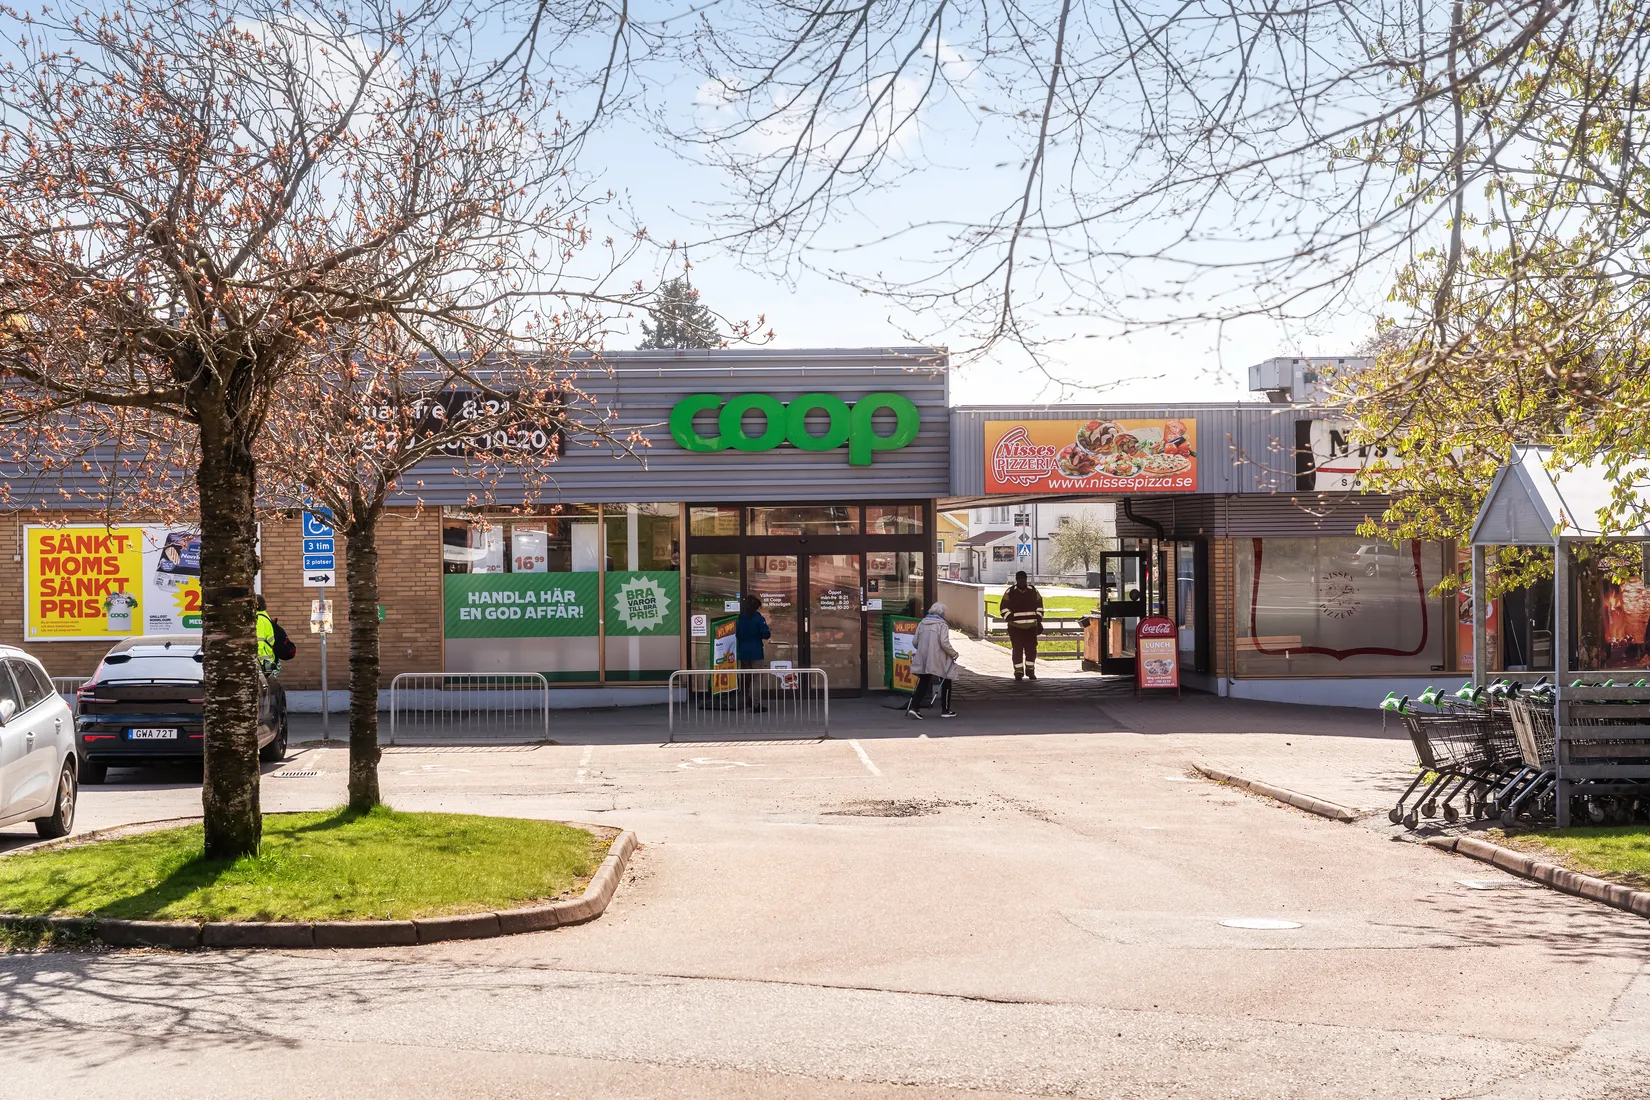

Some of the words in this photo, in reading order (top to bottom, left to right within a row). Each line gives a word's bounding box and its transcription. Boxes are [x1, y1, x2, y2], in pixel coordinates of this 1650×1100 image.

[669, 393, 920, 466] coop
[999, 442, 1056, 456] Nisses
[997, 458, 1060, 469] PIZZERIA
[1048, 476, 1192, 490] www.nissespizza.se
[40, 534, 129, 554] SÄNKT
[316, 542, 330, 550] tim
[40, 556, 120, 576] MOMS
[40, 576, 129, 597] SÄNKT
[626, 588, 655, 600] BRA
[468, 590, 536, 604] HANDLA
[540, 588, 576, 603] HÄR
[628, 598, 656, 606] VAROR
[40, 598, 107, 618] PRIS.
[460, 607, 482, 620] EN
[485, 606, 521, 619] GOD
[525, 603, 583, 619] AFFÄR!
[629, 610, 658, 620] PRIS!
[894, 664, 912, 684] 42
[136, 729, 153, 738] GWA
[156, 729, 174, 738] 72T
